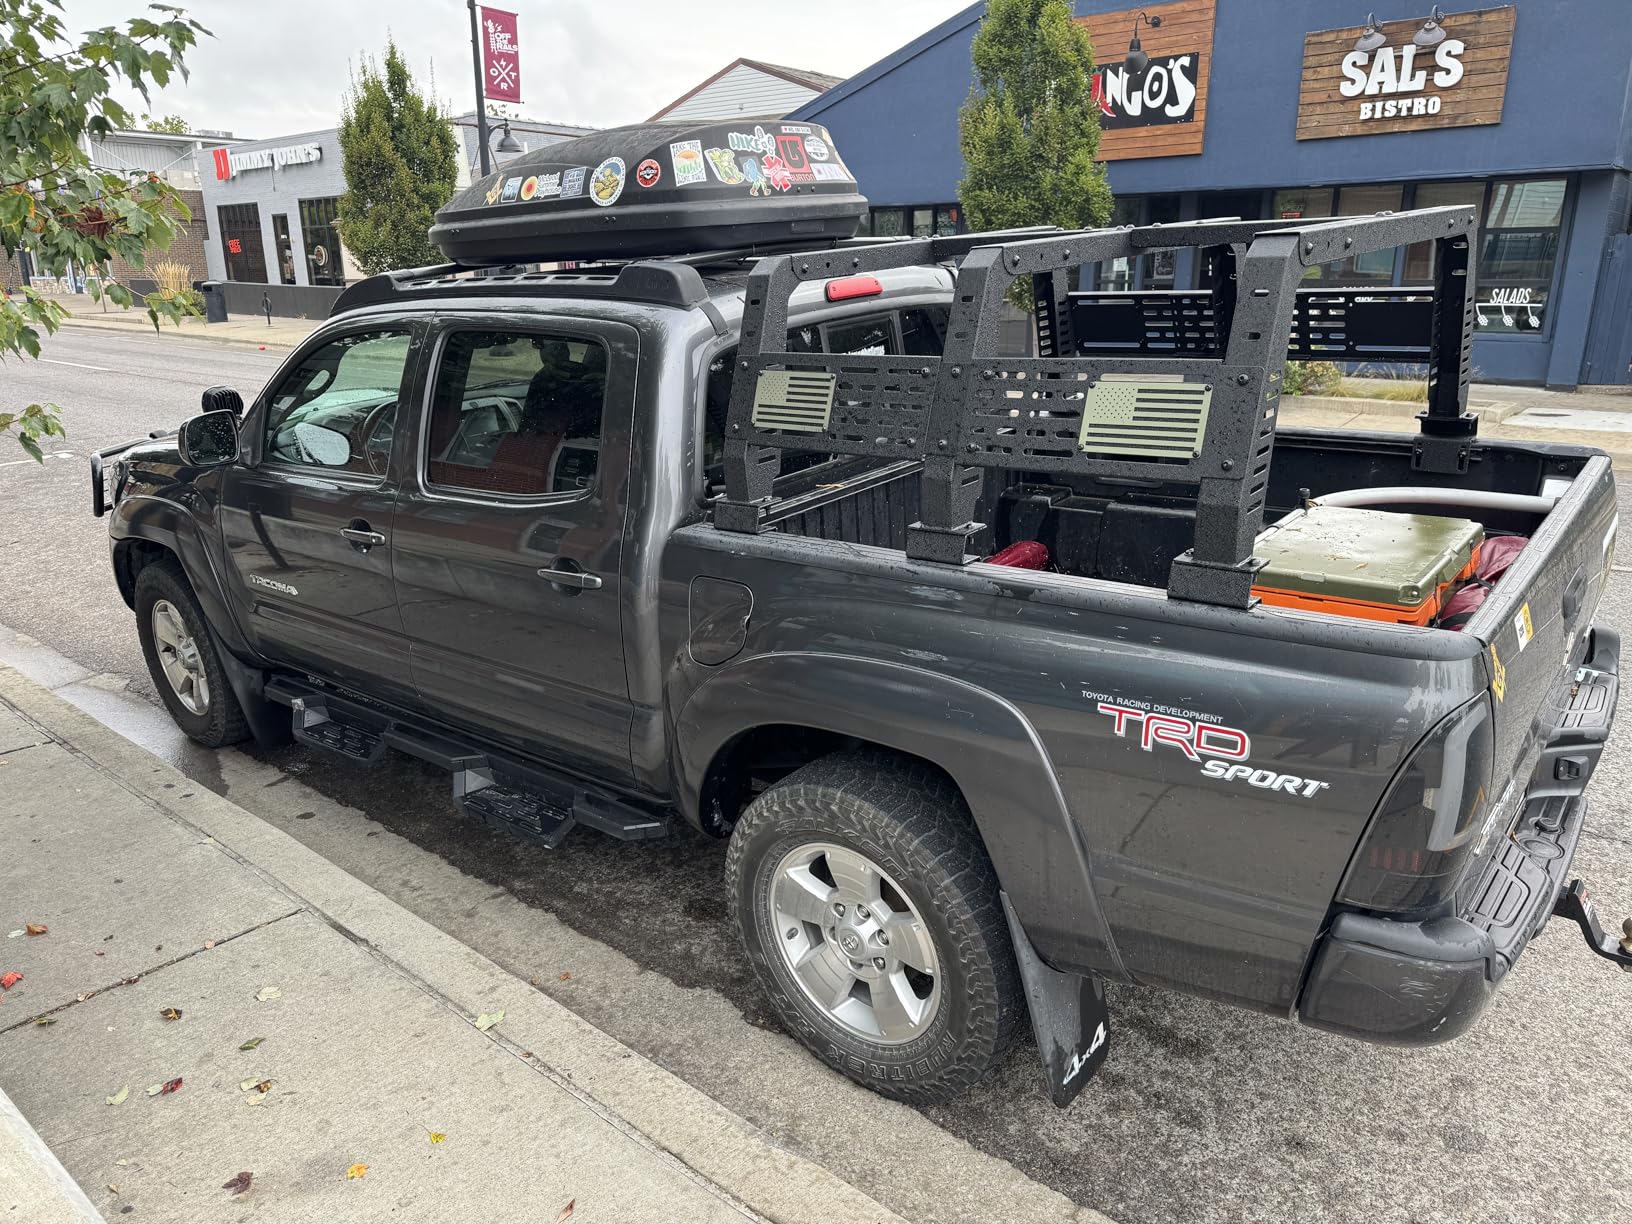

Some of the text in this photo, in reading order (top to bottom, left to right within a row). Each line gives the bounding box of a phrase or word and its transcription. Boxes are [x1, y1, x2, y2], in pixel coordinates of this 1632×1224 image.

[496, 42, 518, 52] RAILS
[1360, 96, 1441, 120] BISTRO
[230, 142, 321, 177] JIMMY JOHN'S
[789, 173, 817, 182] BURTON
[1489, 288, 1533, 304] SALADS
[1081, 690, 1224, 724] TOYOTA RACING DEVELOPMENT
[1097, 702, 1251, 763] TRD
[1200, 759, 1330, 798] SPORT
[1062, 1020, 1107, 1086] 4x4
